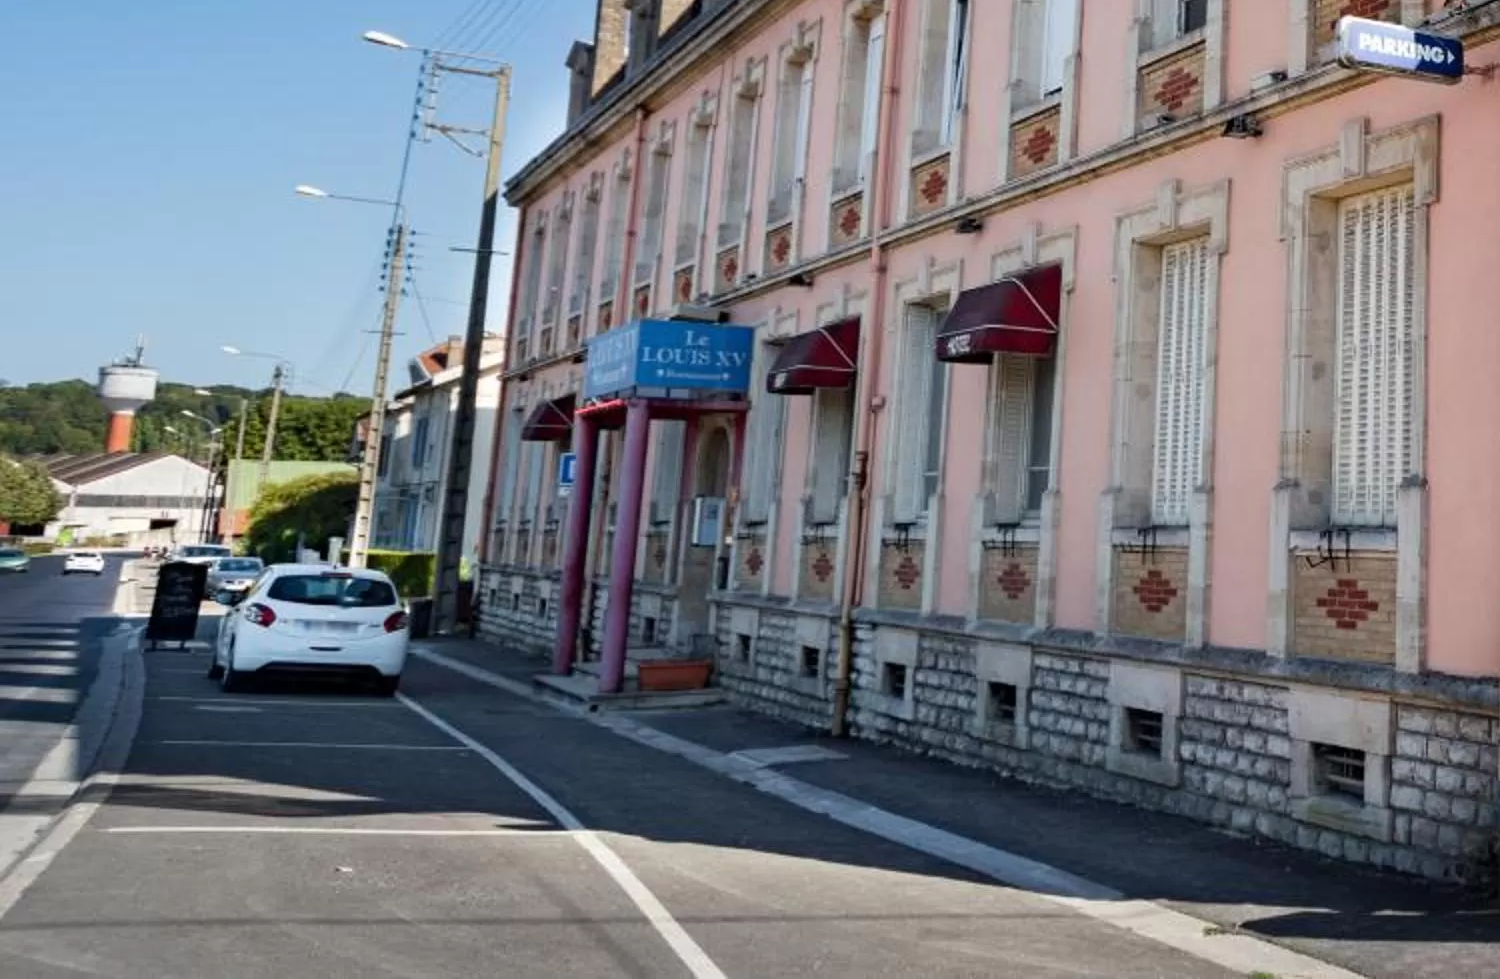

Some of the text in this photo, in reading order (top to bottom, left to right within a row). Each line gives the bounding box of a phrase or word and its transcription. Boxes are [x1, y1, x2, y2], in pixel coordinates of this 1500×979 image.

[1358, 32, 1445, 64] PARKING
[685, 329, 711, 346] Le
[642, 346, 711, 366] LOUIS
